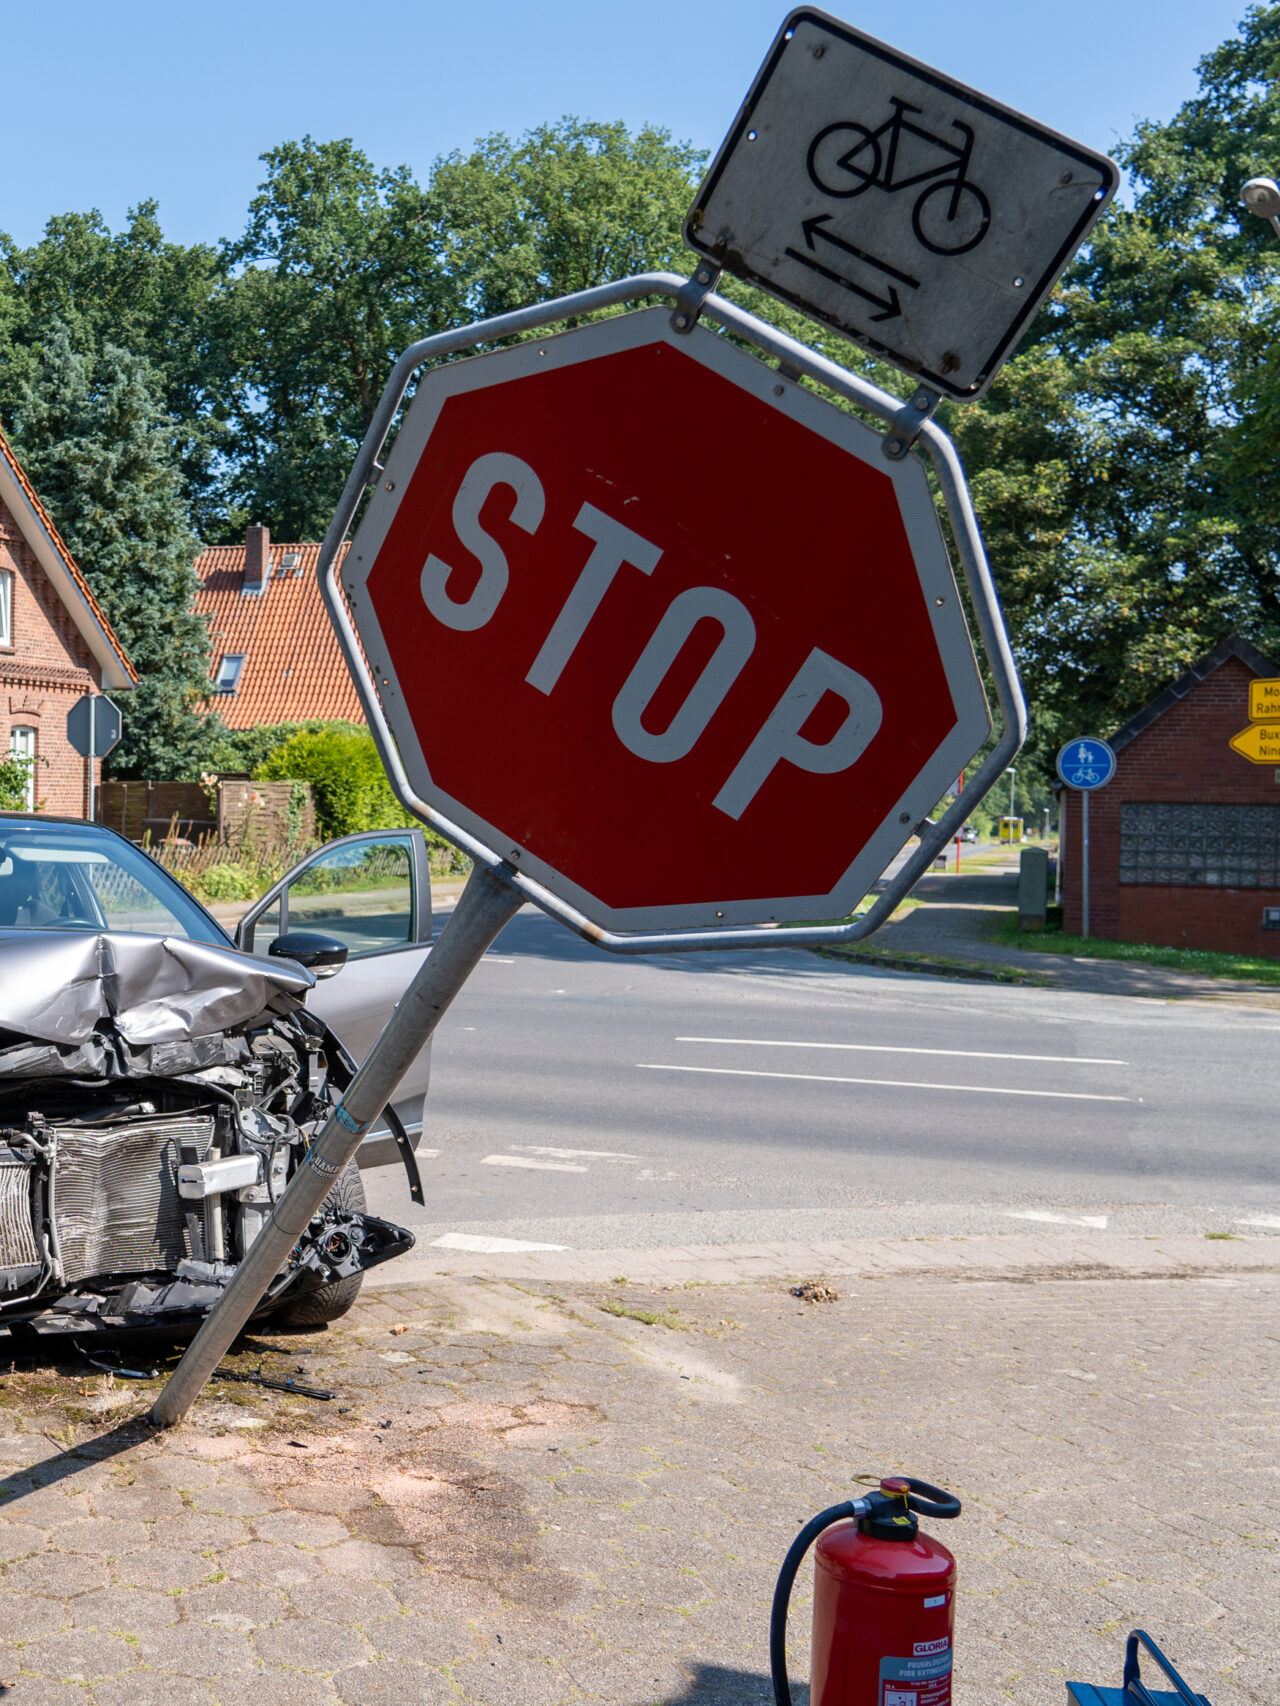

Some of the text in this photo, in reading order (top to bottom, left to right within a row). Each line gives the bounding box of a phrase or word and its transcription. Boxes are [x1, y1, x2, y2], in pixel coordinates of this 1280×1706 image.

[420, 451, 883, 821] STOP
[914, 1639, 948, 1653] GLORIA
[899, 1669, 915, 1677] FIRE
